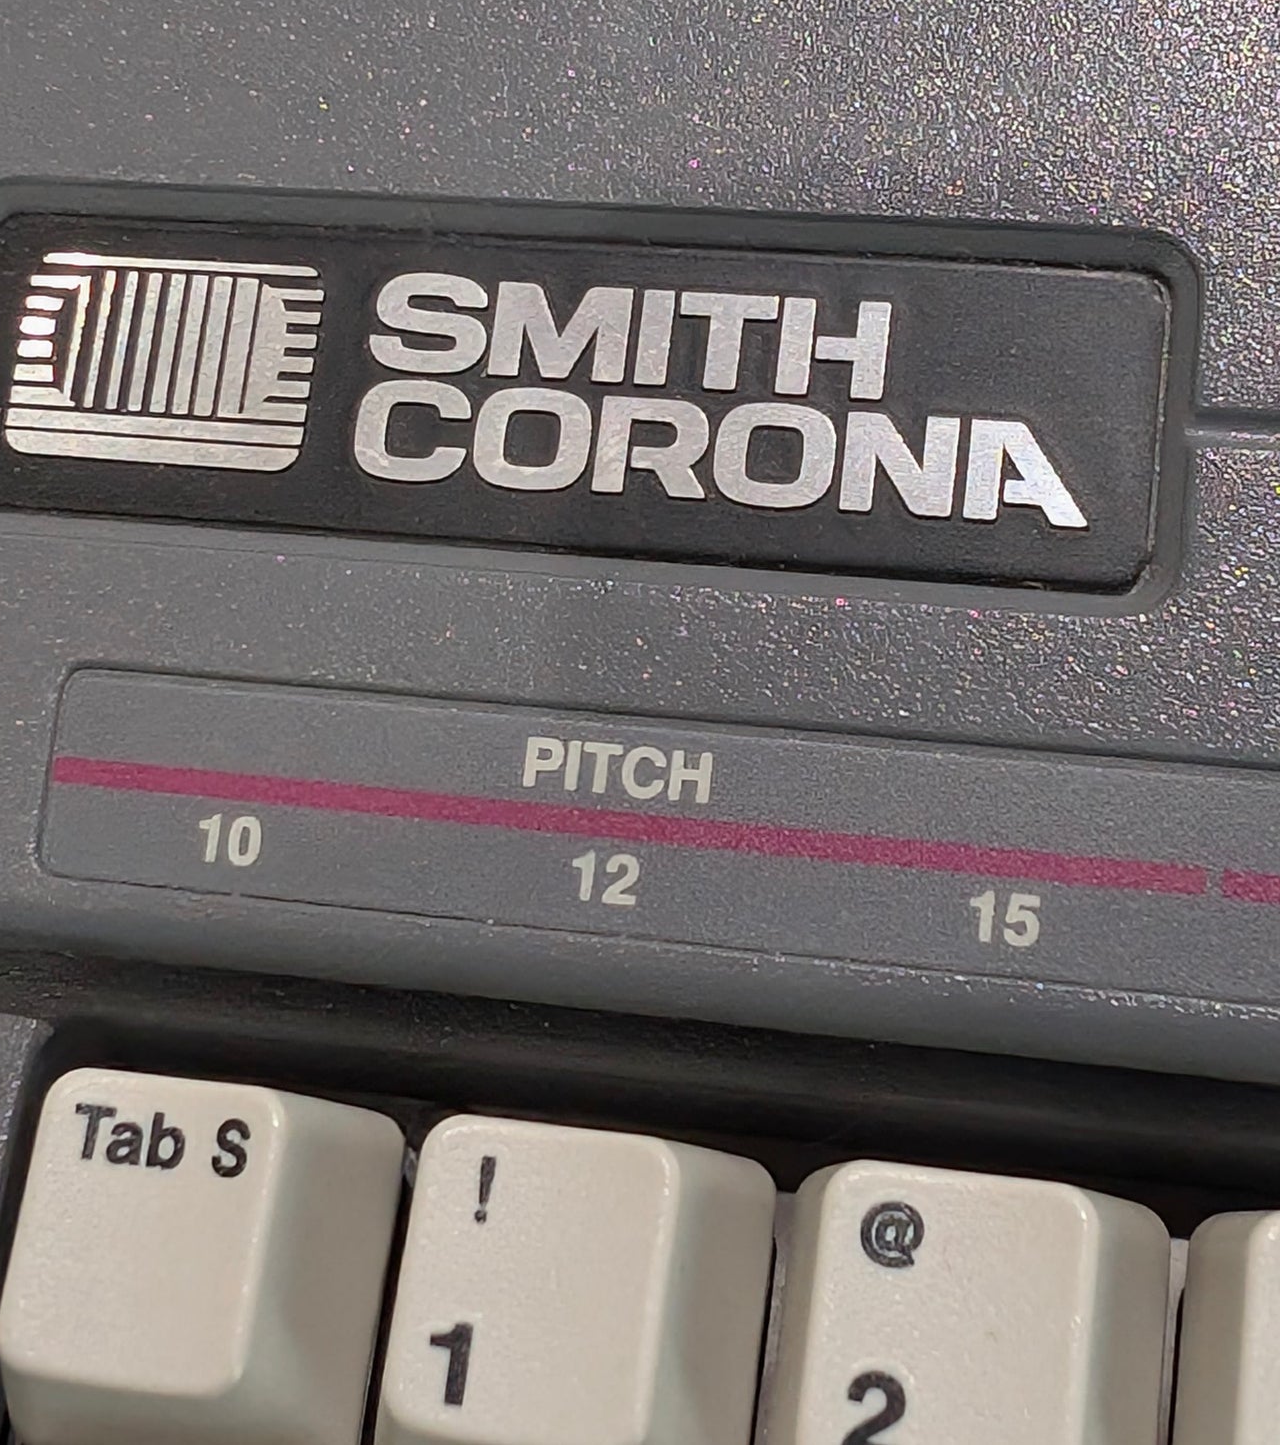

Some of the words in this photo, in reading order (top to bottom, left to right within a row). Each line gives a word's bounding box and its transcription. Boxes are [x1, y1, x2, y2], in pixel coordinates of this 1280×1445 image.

[368, 272, 893, 400] SMITH
[353, 379, 1088, 529] CORONA
[522, 736, 713, 804] PITCH
[198, 813, 262, 867] 10
[571, 850, 640, 906] 12
[969, 890, 1041, 947] 15
[74, 1102, 186, 1171] Tab
[211, 1118, 251, 1179] S
[473, 1155, 497, 1224] !
[859, 1201, 925, 1270] @
[429, 1322, 474, 1407] 1
[841, 1370, 907, 1445] 2
